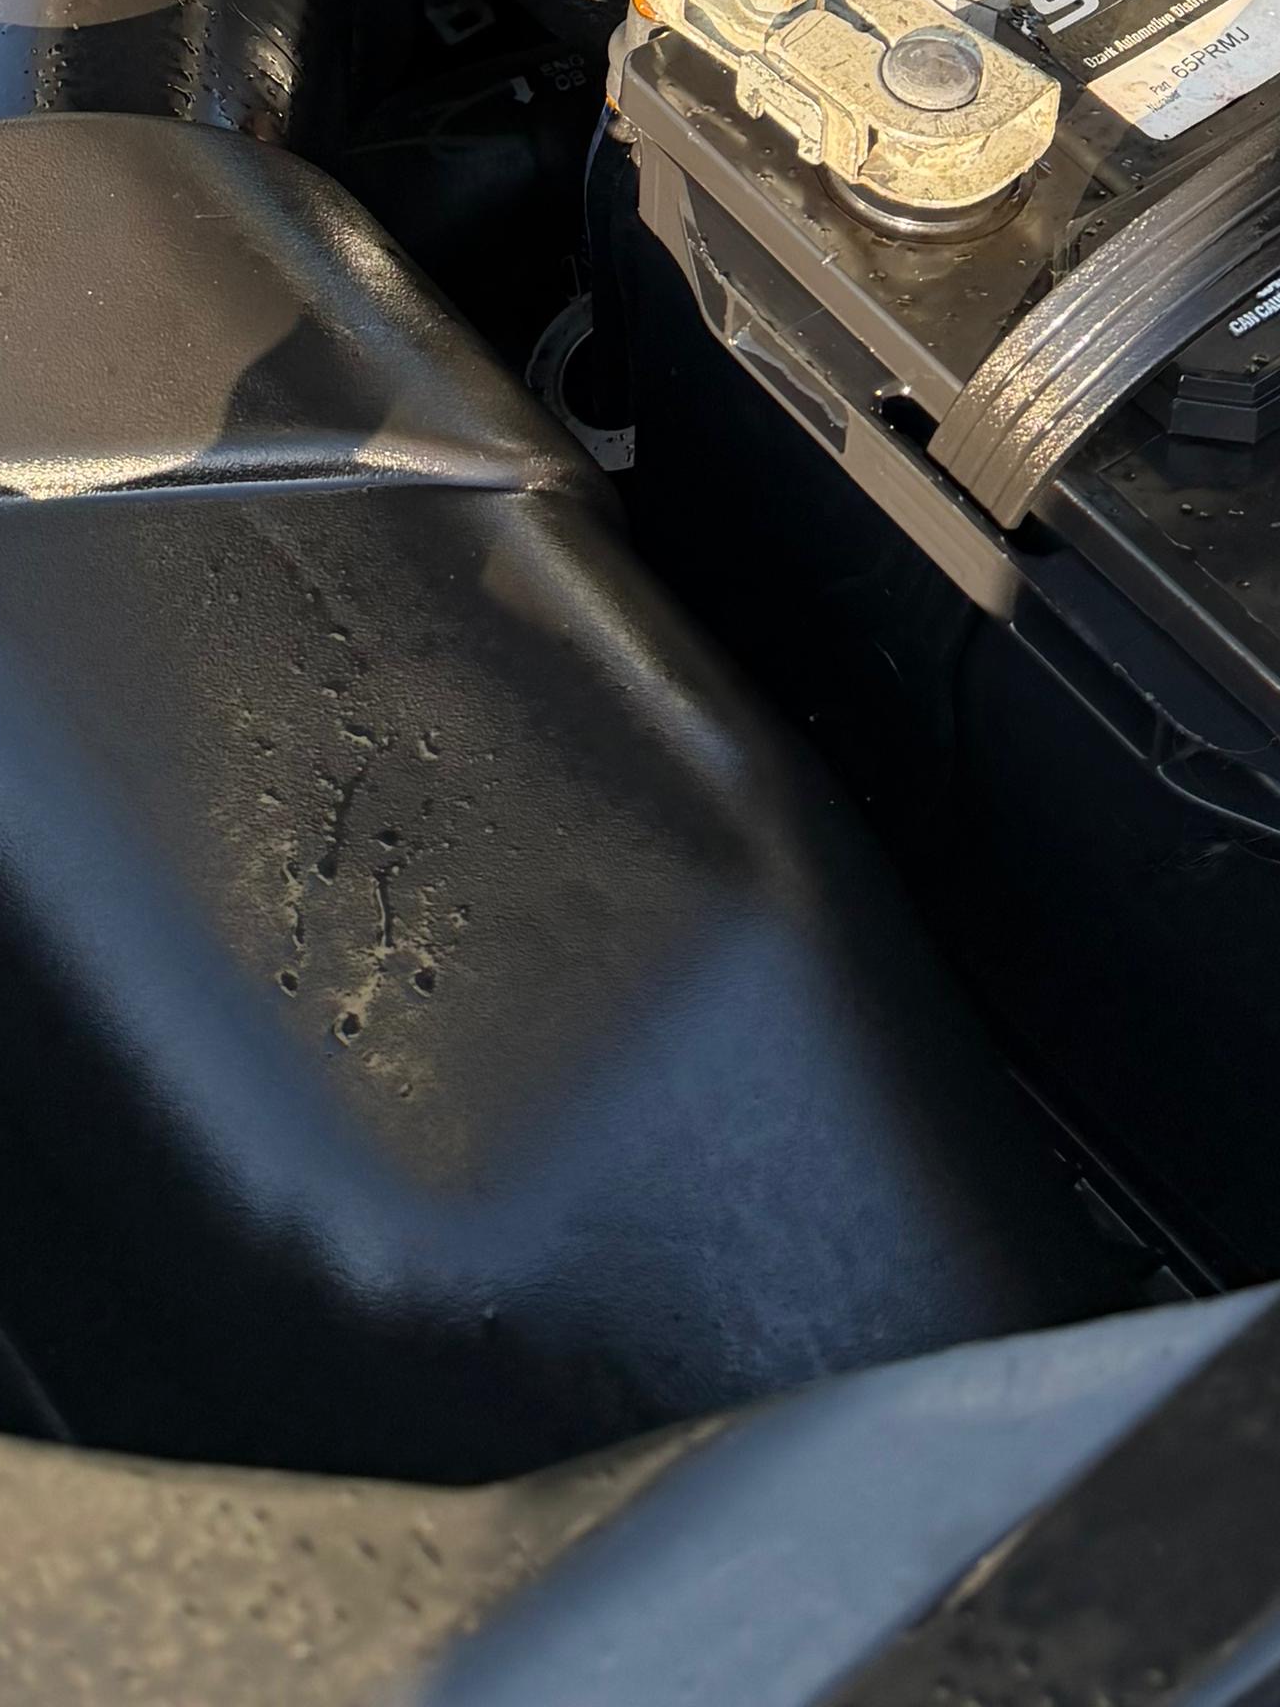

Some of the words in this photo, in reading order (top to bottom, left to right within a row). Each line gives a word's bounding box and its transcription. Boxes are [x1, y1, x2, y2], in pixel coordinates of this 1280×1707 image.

[1082, 42, 1119, 70] Ozark
[1112, 9, 1176, 53] Automotive
[1167, 23, 1252, 81] 65PRMJ
[1225, 311, 1262, 334] CAN
